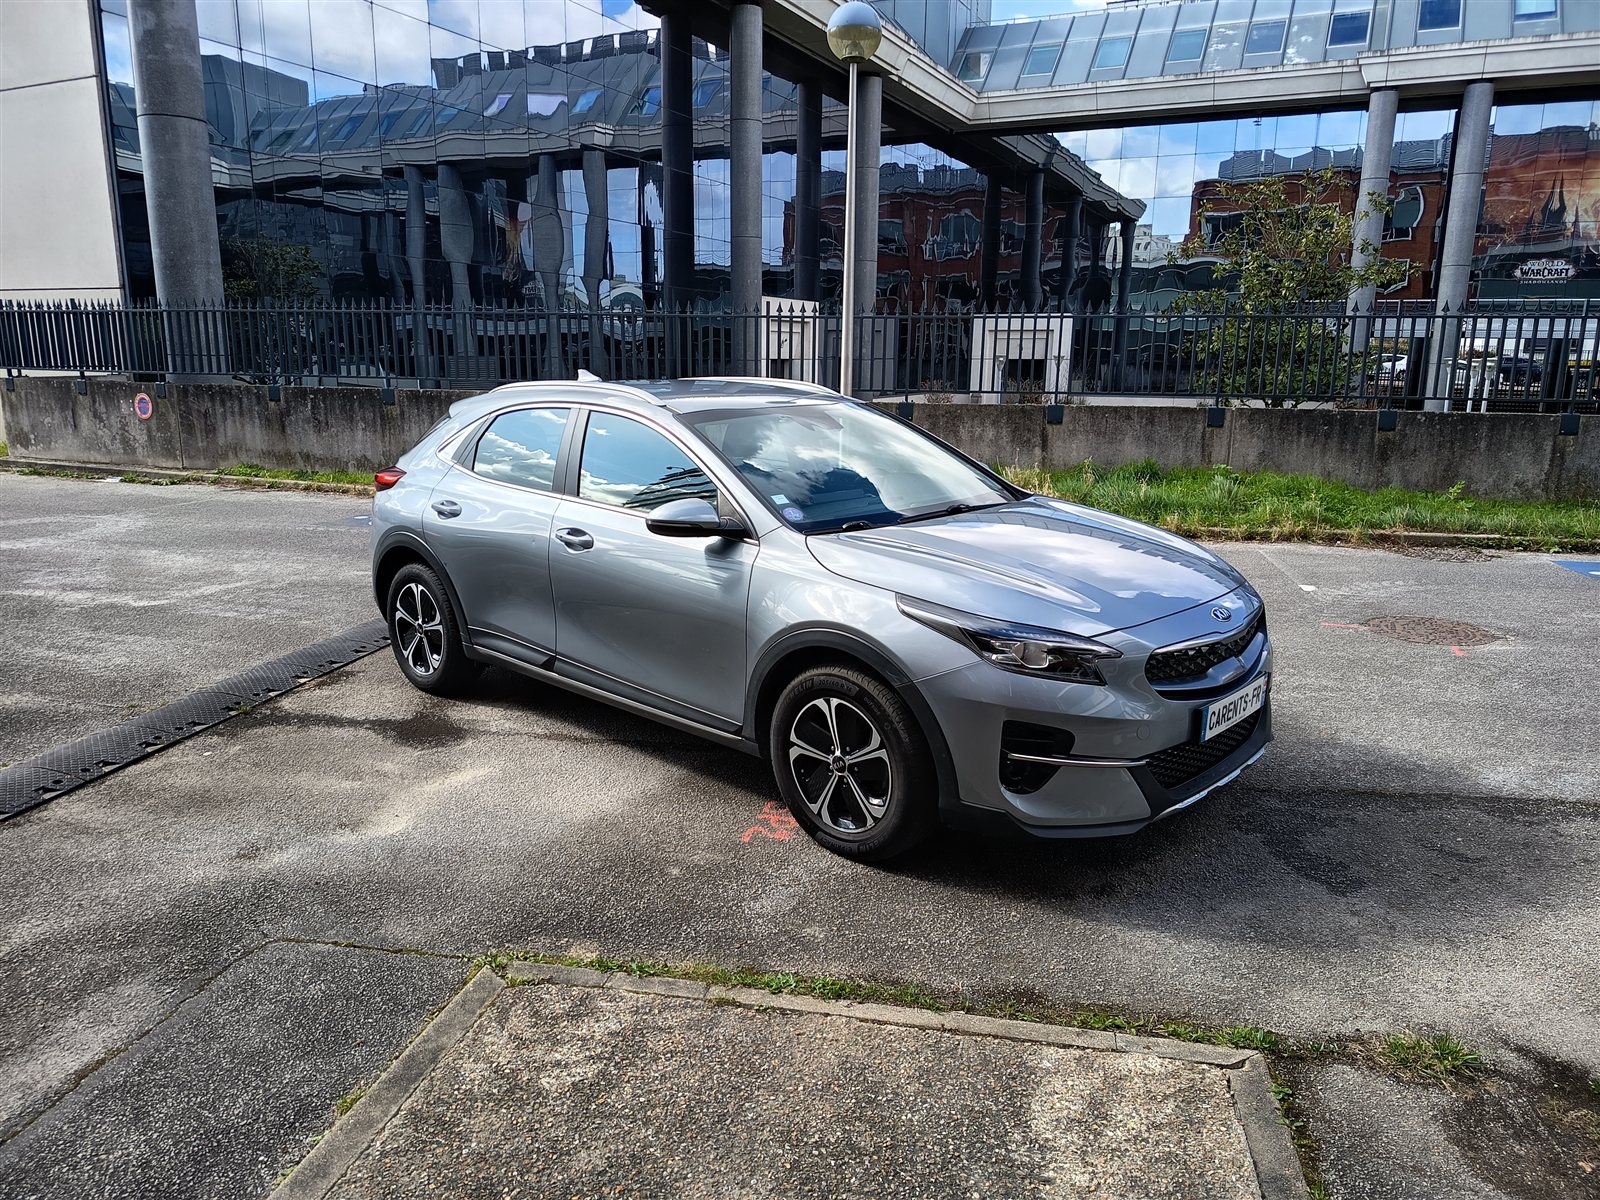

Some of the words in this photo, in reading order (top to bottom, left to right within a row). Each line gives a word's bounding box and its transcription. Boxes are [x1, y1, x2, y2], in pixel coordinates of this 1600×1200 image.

[1519, 267, 1570, 278] WARCRAFT
[1212, 608, 1231, 620] KIA
[1208, 685, 1262, 731] CARENTS-FR
[833, 760, 845, 770] KIA
